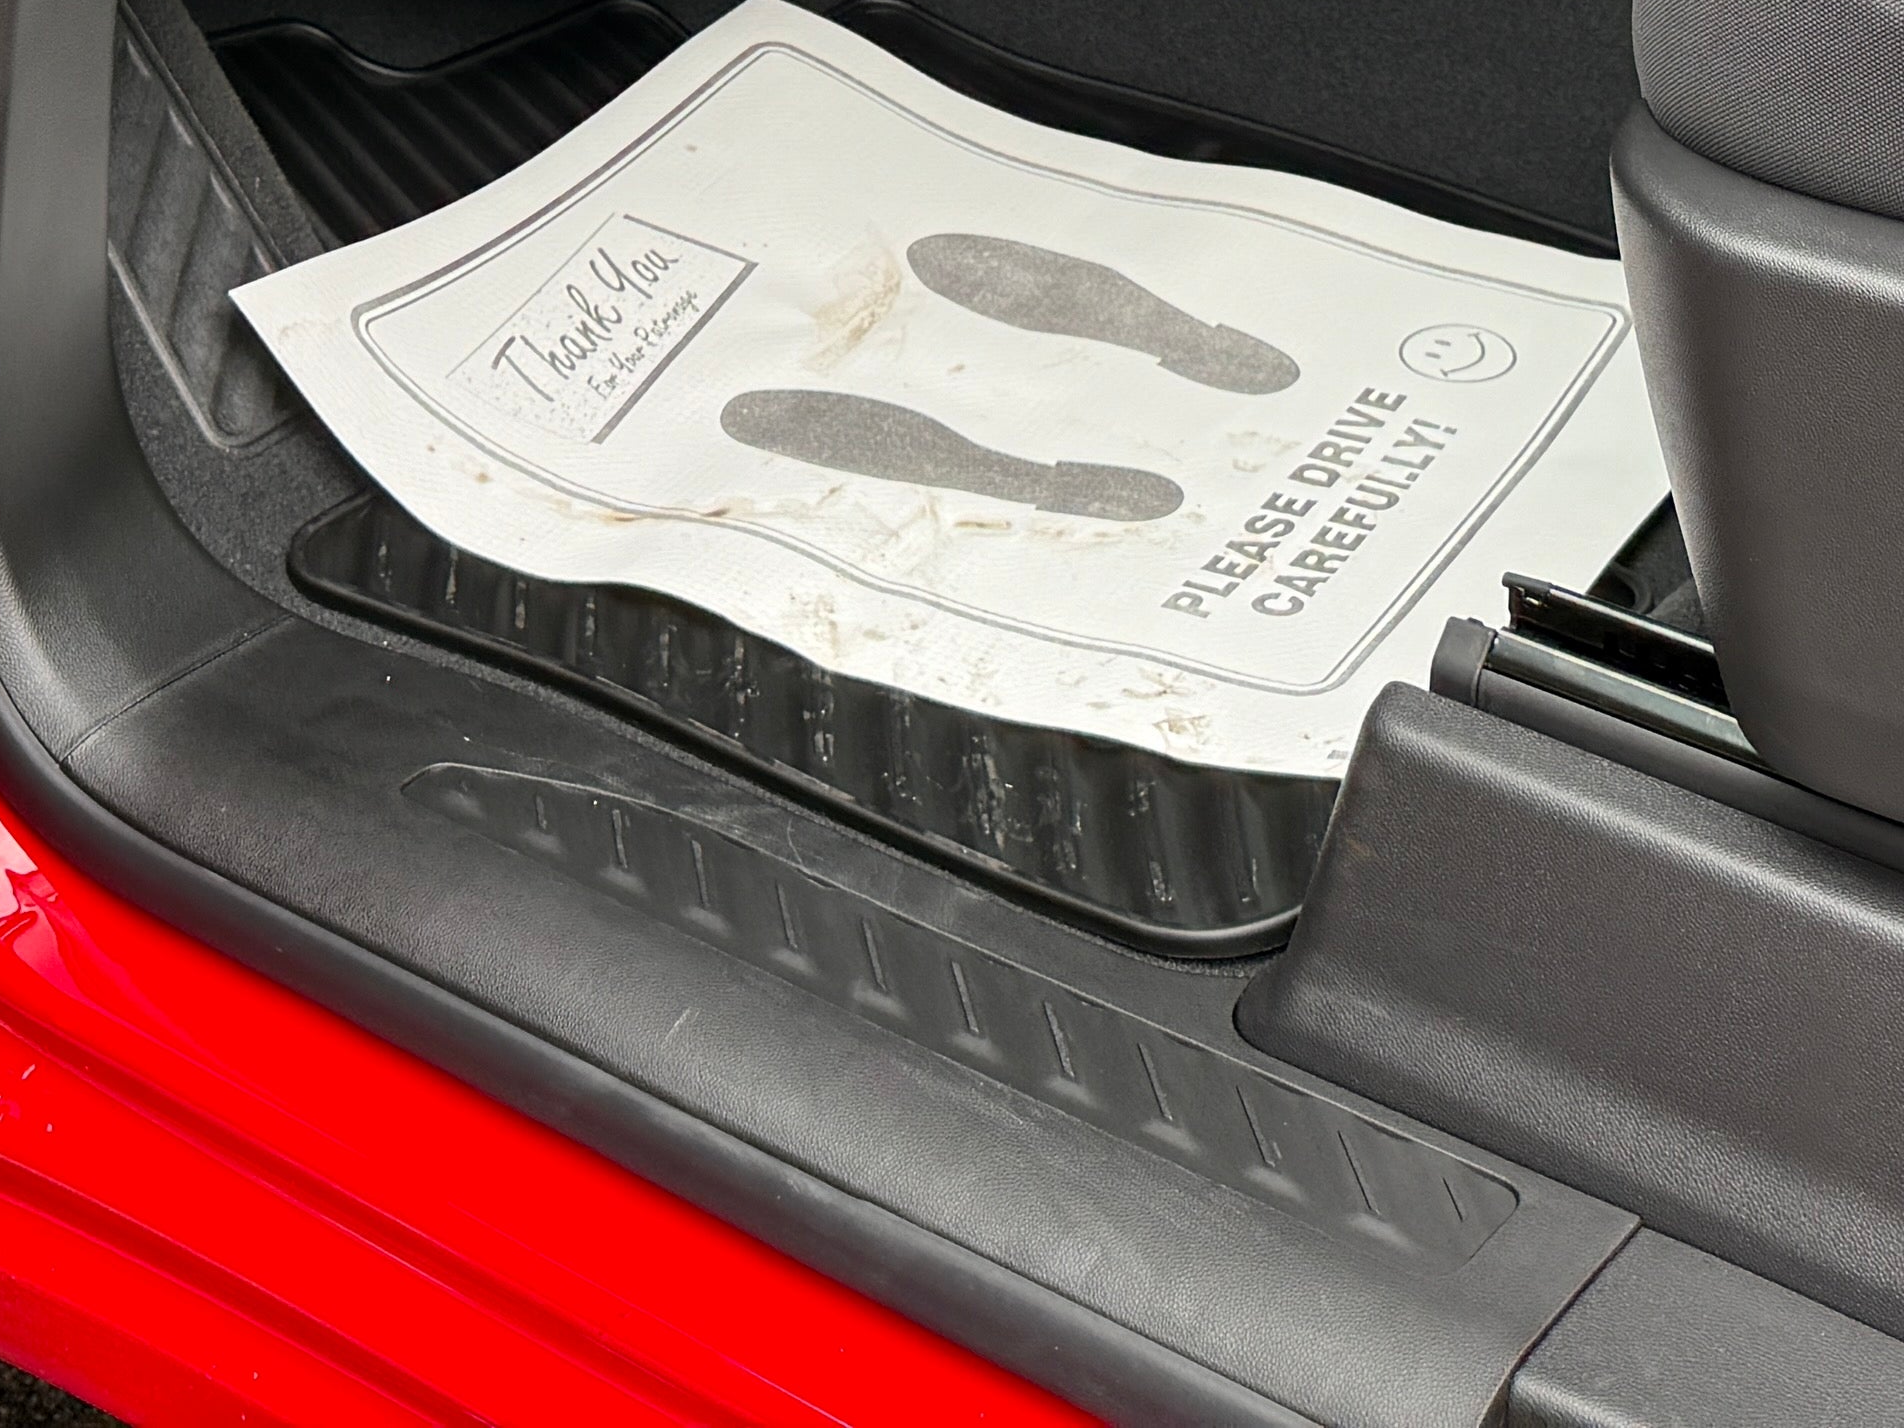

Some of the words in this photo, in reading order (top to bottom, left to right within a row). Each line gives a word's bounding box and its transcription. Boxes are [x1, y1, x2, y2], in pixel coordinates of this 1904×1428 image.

[491, 283, 623, 403] Thank
[588, 247, 680, 300] You
[1160, 491, 1319, 620] PLEASE
[1287, 387, 1408, 489] DRIVE
[1250, 417, 1459, 617] CAREFULLY!
